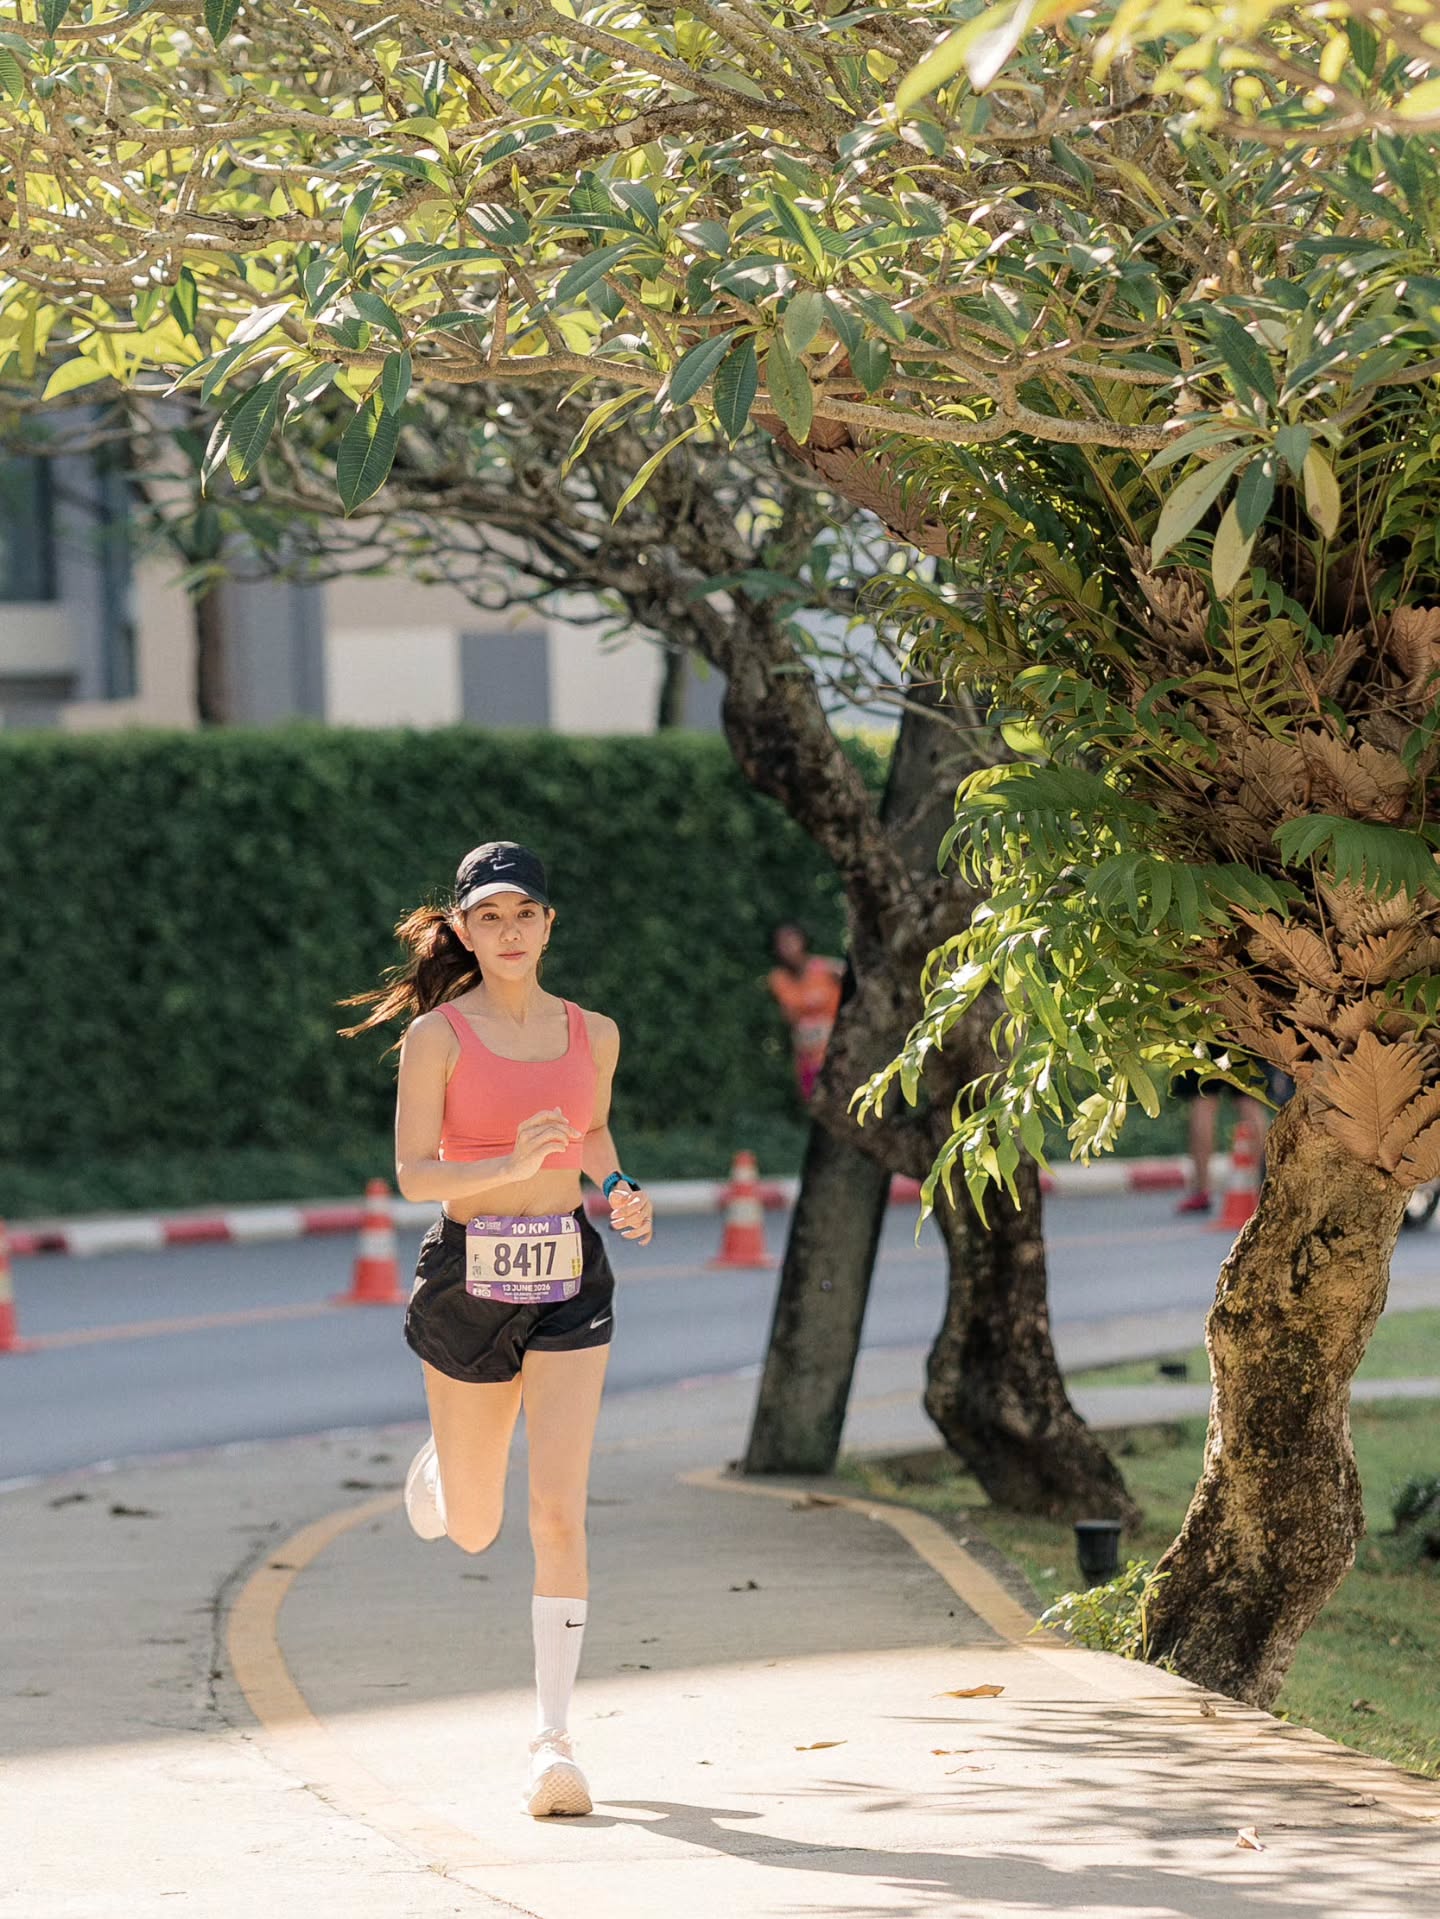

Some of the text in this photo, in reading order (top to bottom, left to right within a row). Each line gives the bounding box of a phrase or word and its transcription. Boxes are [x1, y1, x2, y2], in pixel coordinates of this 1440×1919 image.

[511, 1223, 526, 1234] 10
[529, 1222, 549, 1233] KM
[565, 1221, 571, 1230] A
[474, 1254, 480, 1262] F
[494, 1242, 557, 1276] 8417
[512, 1284, 532, 1292] JUNE
[533, 1283, 551, 1291] 2026
